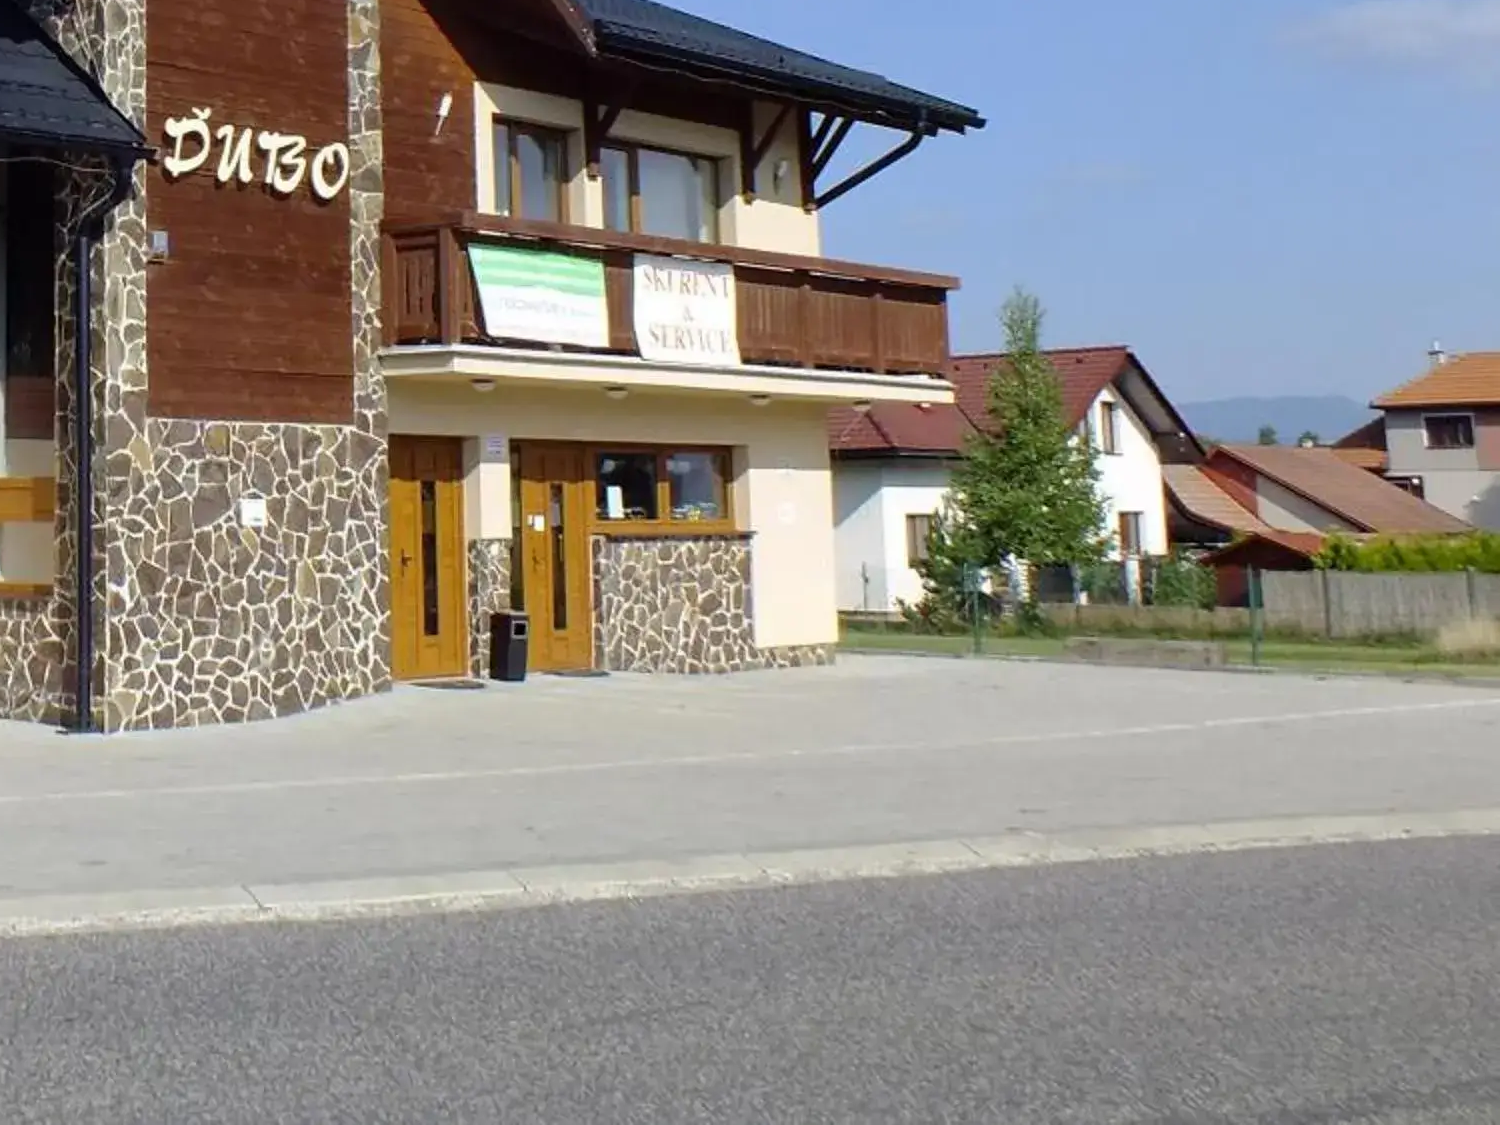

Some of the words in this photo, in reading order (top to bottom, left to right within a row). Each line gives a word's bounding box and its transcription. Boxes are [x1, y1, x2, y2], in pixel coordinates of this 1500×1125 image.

[643, 265, 673, 293] SKI
[679, 270, 731, 298] RENT
[648, 321, 733, 354] SERVICE
